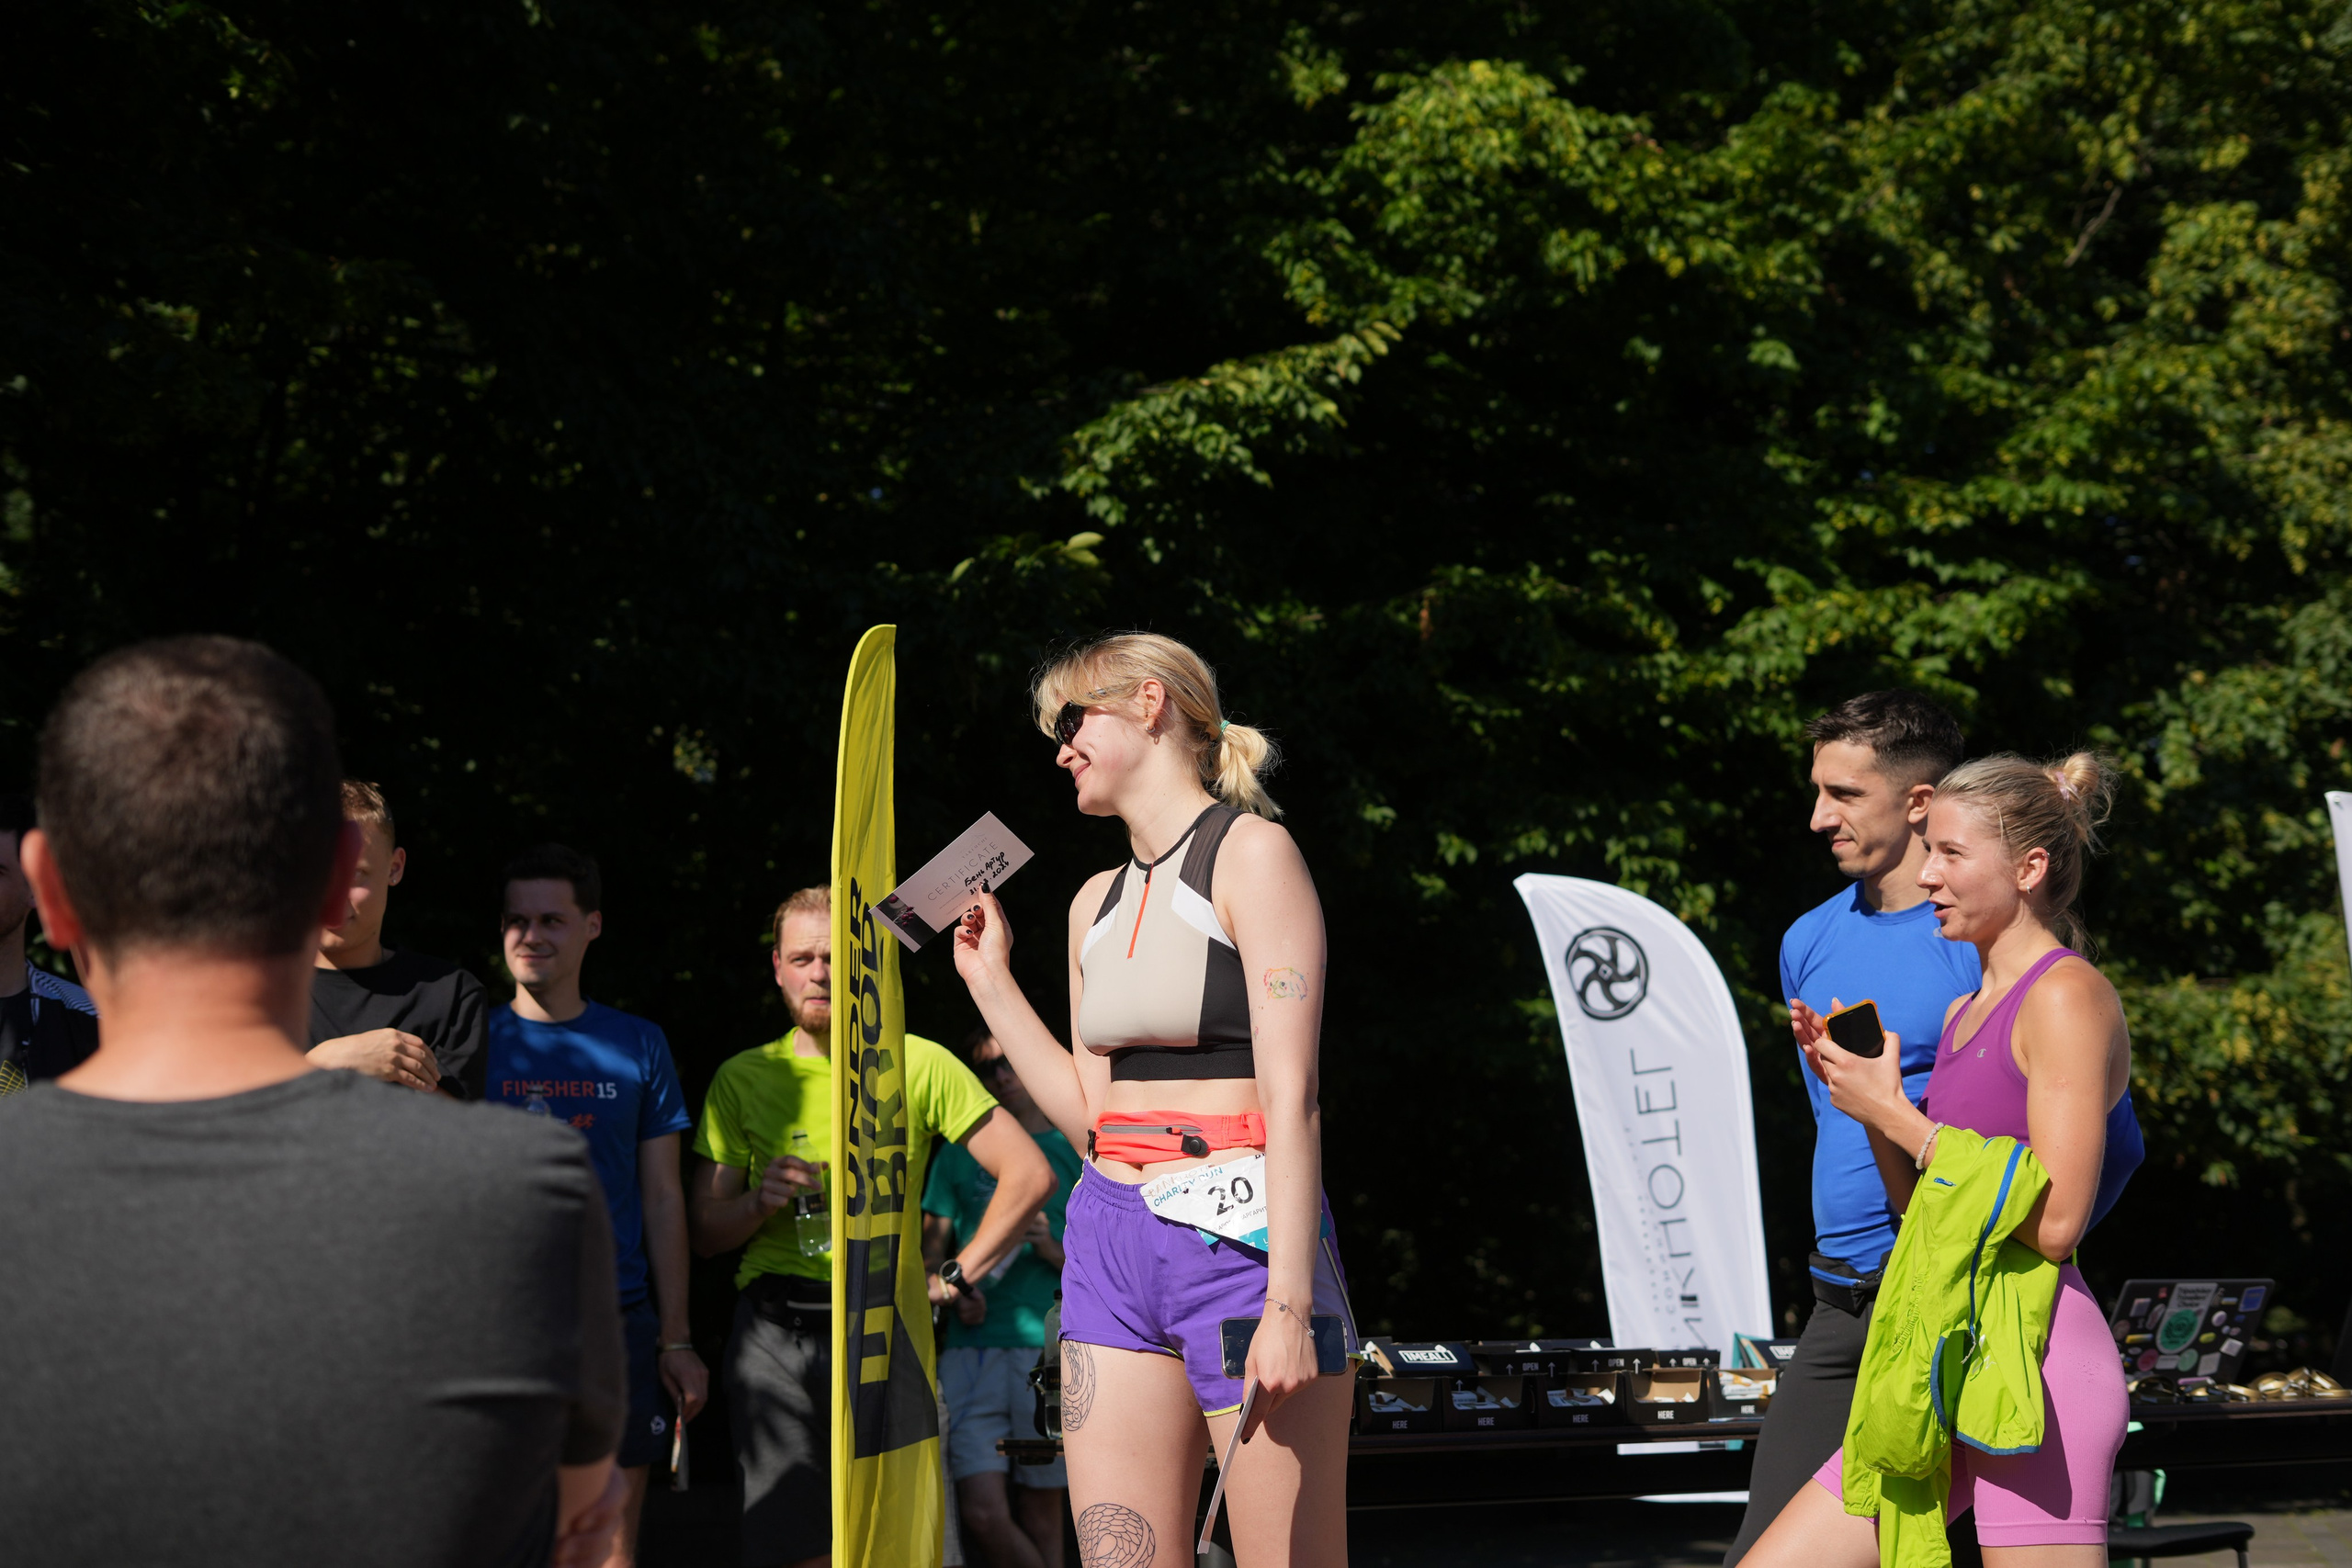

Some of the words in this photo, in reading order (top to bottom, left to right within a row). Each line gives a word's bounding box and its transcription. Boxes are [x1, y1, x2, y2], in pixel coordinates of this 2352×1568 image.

[927, 841, 998, 901] CERTIFICATE
[847, 875, 866, 1217] UNDER
[1153, 1179, 1195, 1207] CHARITY
[1207, 1177, 1254, 1216] 20
[1522, 1362, 1539, 1371] OPEN
[1608, 1359, 1624, 1368] OPEN
[1682, 1358, 1697, 1367] OPEN
[1740, 1404, 1756, 1414] HERE
[1572, 1414, 1589, 1423] HERE
[1657, 1410, 1674, 1419] HERE
[1392, 1420, 1408, 1429] HERE
[1477, 1416, 1495, 1426] HERE
